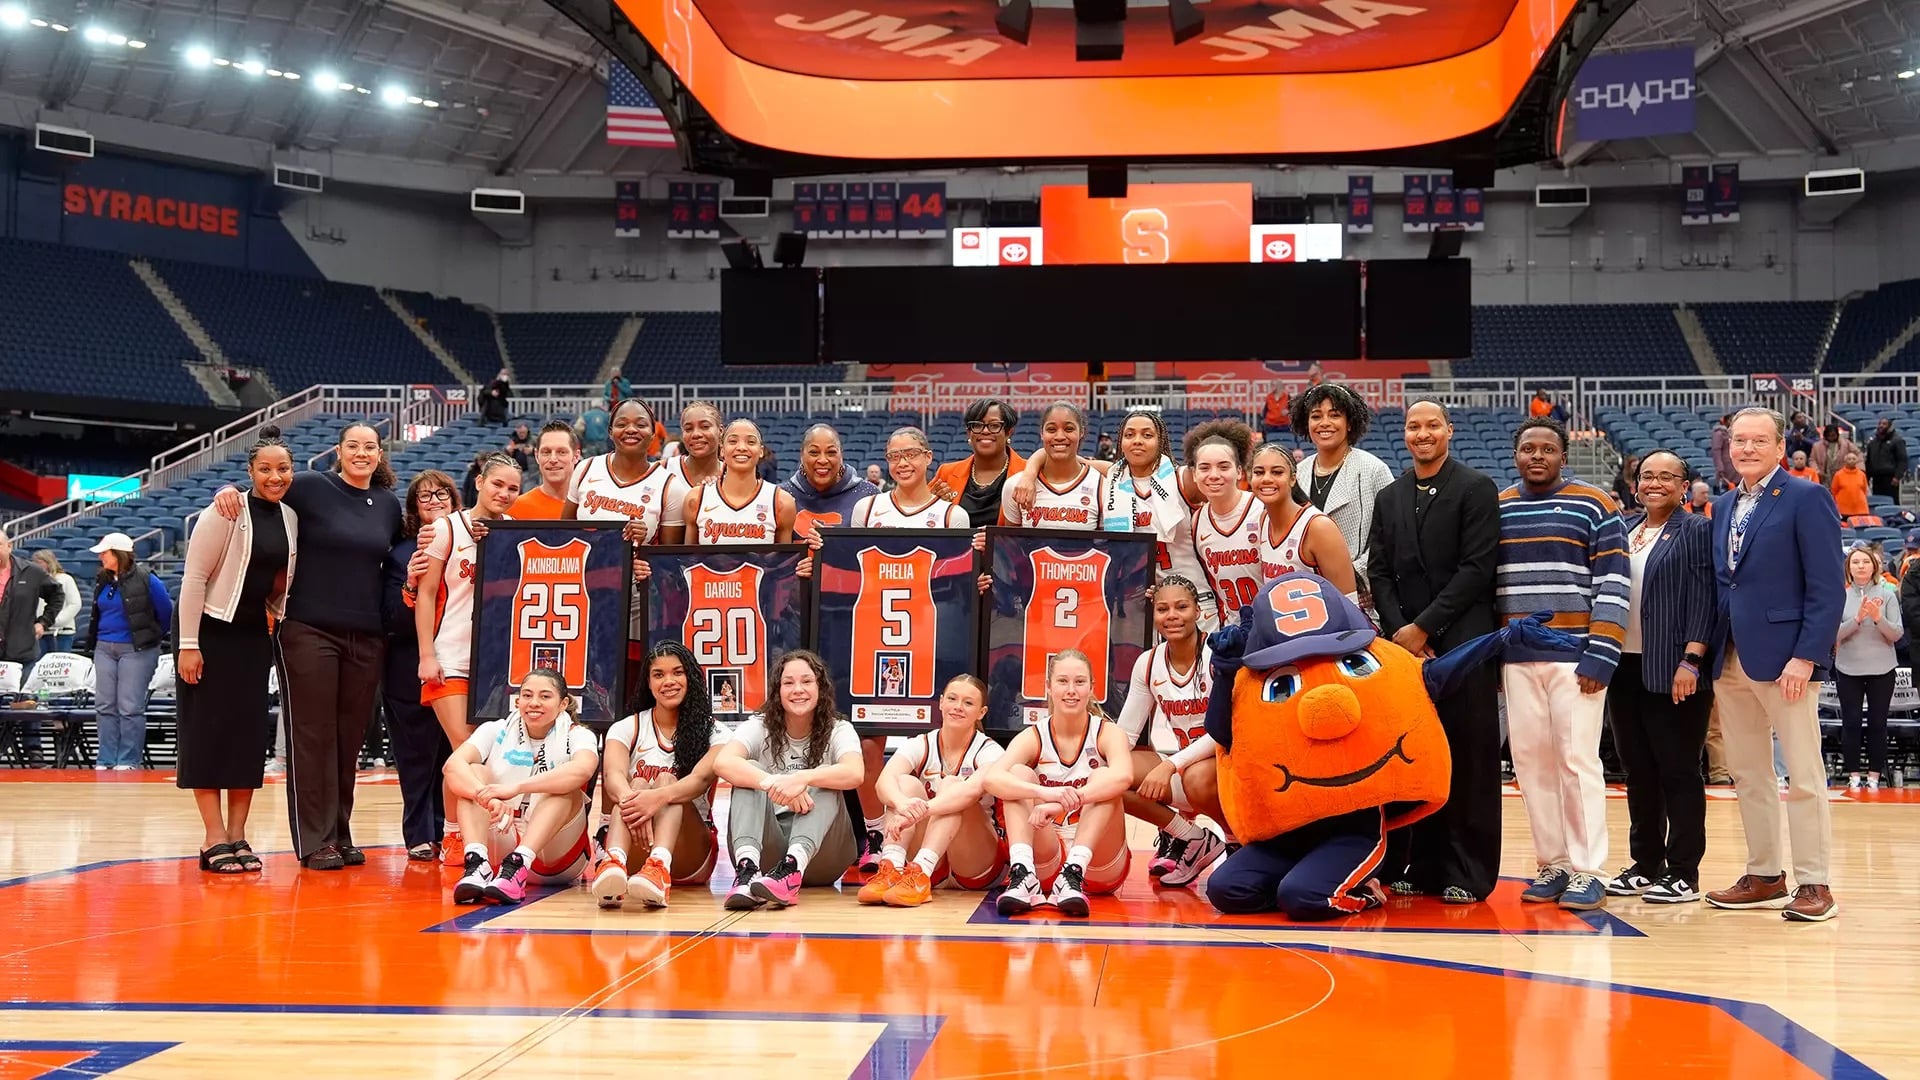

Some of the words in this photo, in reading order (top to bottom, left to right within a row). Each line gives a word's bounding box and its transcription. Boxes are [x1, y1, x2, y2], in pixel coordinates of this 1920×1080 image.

[774, 9, 1002, 65] JMA
[1199, 0, 1428, 62] JMA
[64, 183, 240, 237] SYRACUSE
[902, 192, 943, 218] 44
[1121, 207, 1169, 263] S
[414, 389, 431, 401] 121
[446, 389, 466, 400] 122
[1754, 379, 1778, 391] 124
[1791, 378, 1814, 391] 125
[584, 489, 646, 520] Syracuse
[704, 518, 766, 544] Syracuse
[526, 557, 581, 575] AKINBOLAWA
[878, 563, 914, 580] PHELIA
[1039, 561, 1098, 582] THOMPSON
[1205, 547, 1259, 574] Syracuse
[704, 581, 742, 599] DARIUS
[1218, 576, 1259, 611] 30
[519, 582, 581, 641] 25
[880, 588, 911, 647] 5
[1053, 587, 1080, 628] 2
[1269, 578, 1330, 637] S
[691, 607, 758, 666] 20
[37, 668, 62, 676] Level
[857, 707, 866, 719] S
[916, 708, 926, 720] S
